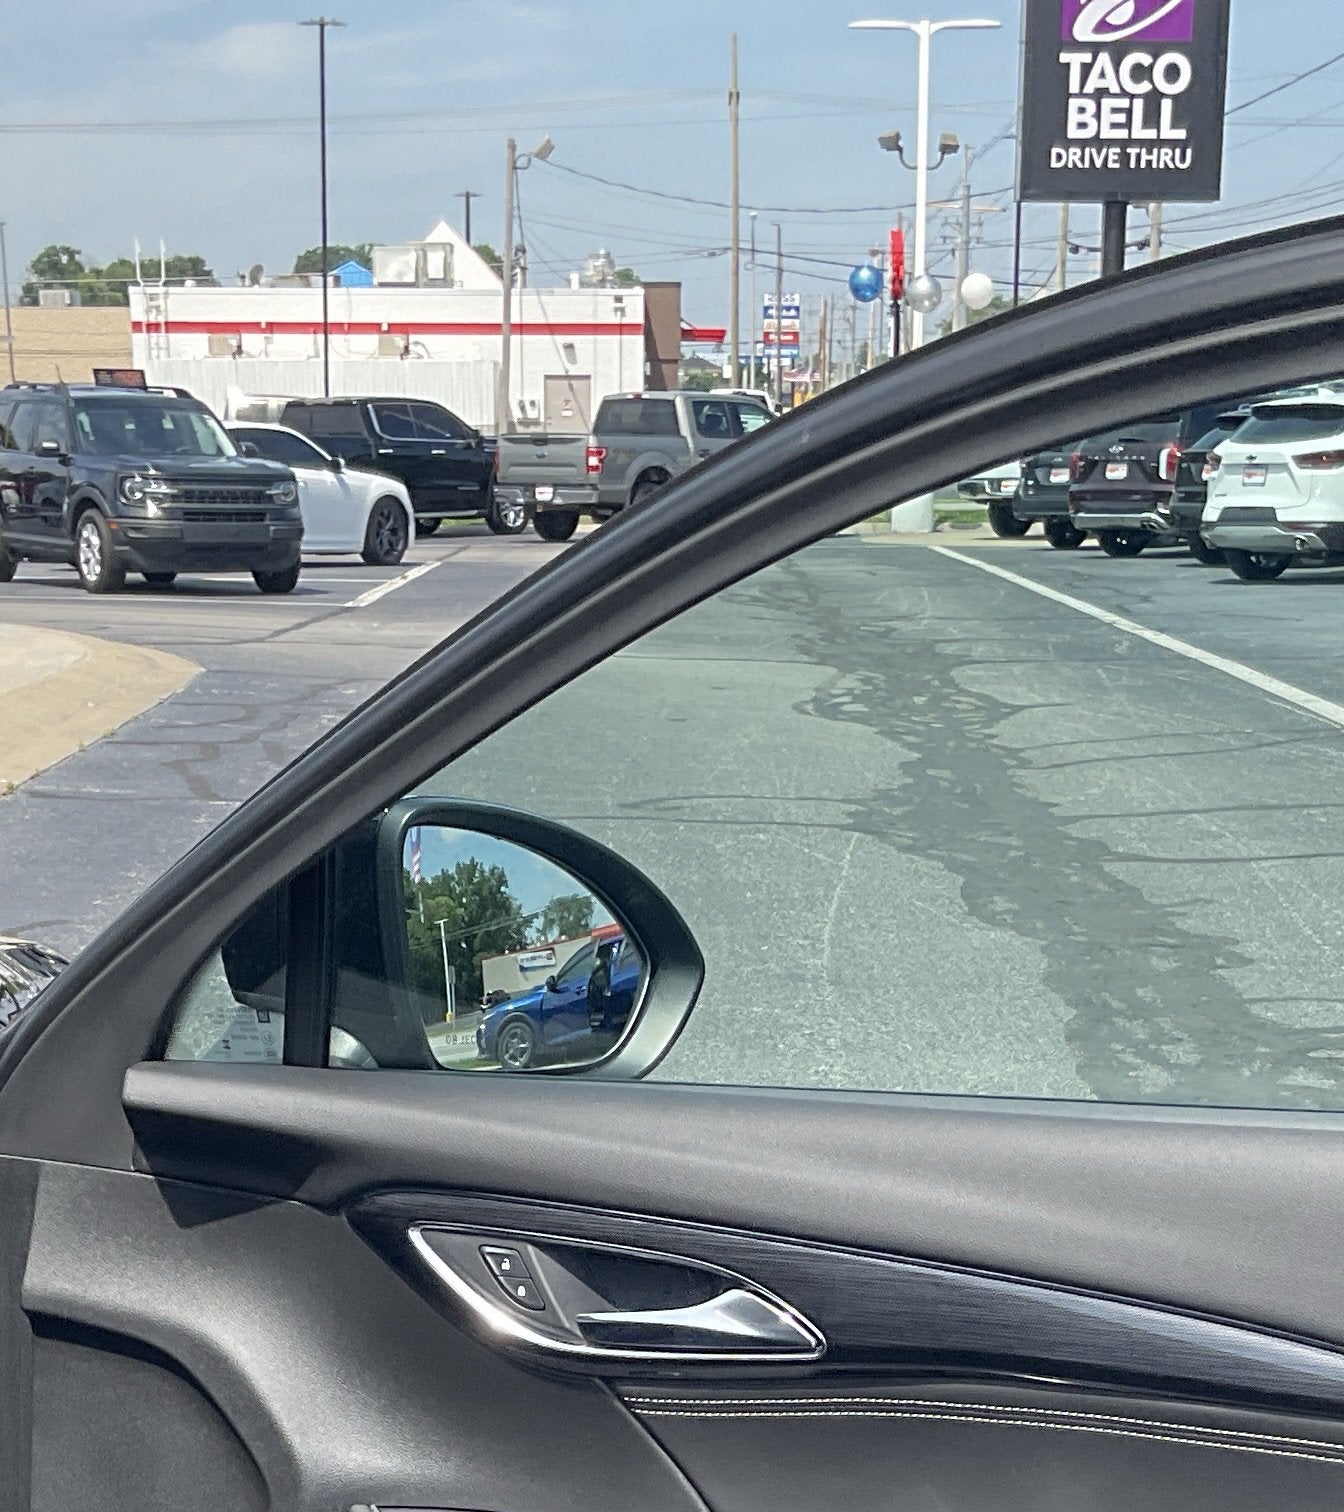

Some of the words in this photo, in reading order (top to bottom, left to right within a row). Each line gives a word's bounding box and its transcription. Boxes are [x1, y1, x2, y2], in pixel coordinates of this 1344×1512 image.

[1058, 51, 1192, 96] TACO
[1066, 97, 1187, 140] BELL
[1049, 147, 1121, 169] DRIVE
[1126, 147, 1192, 169] THRU
